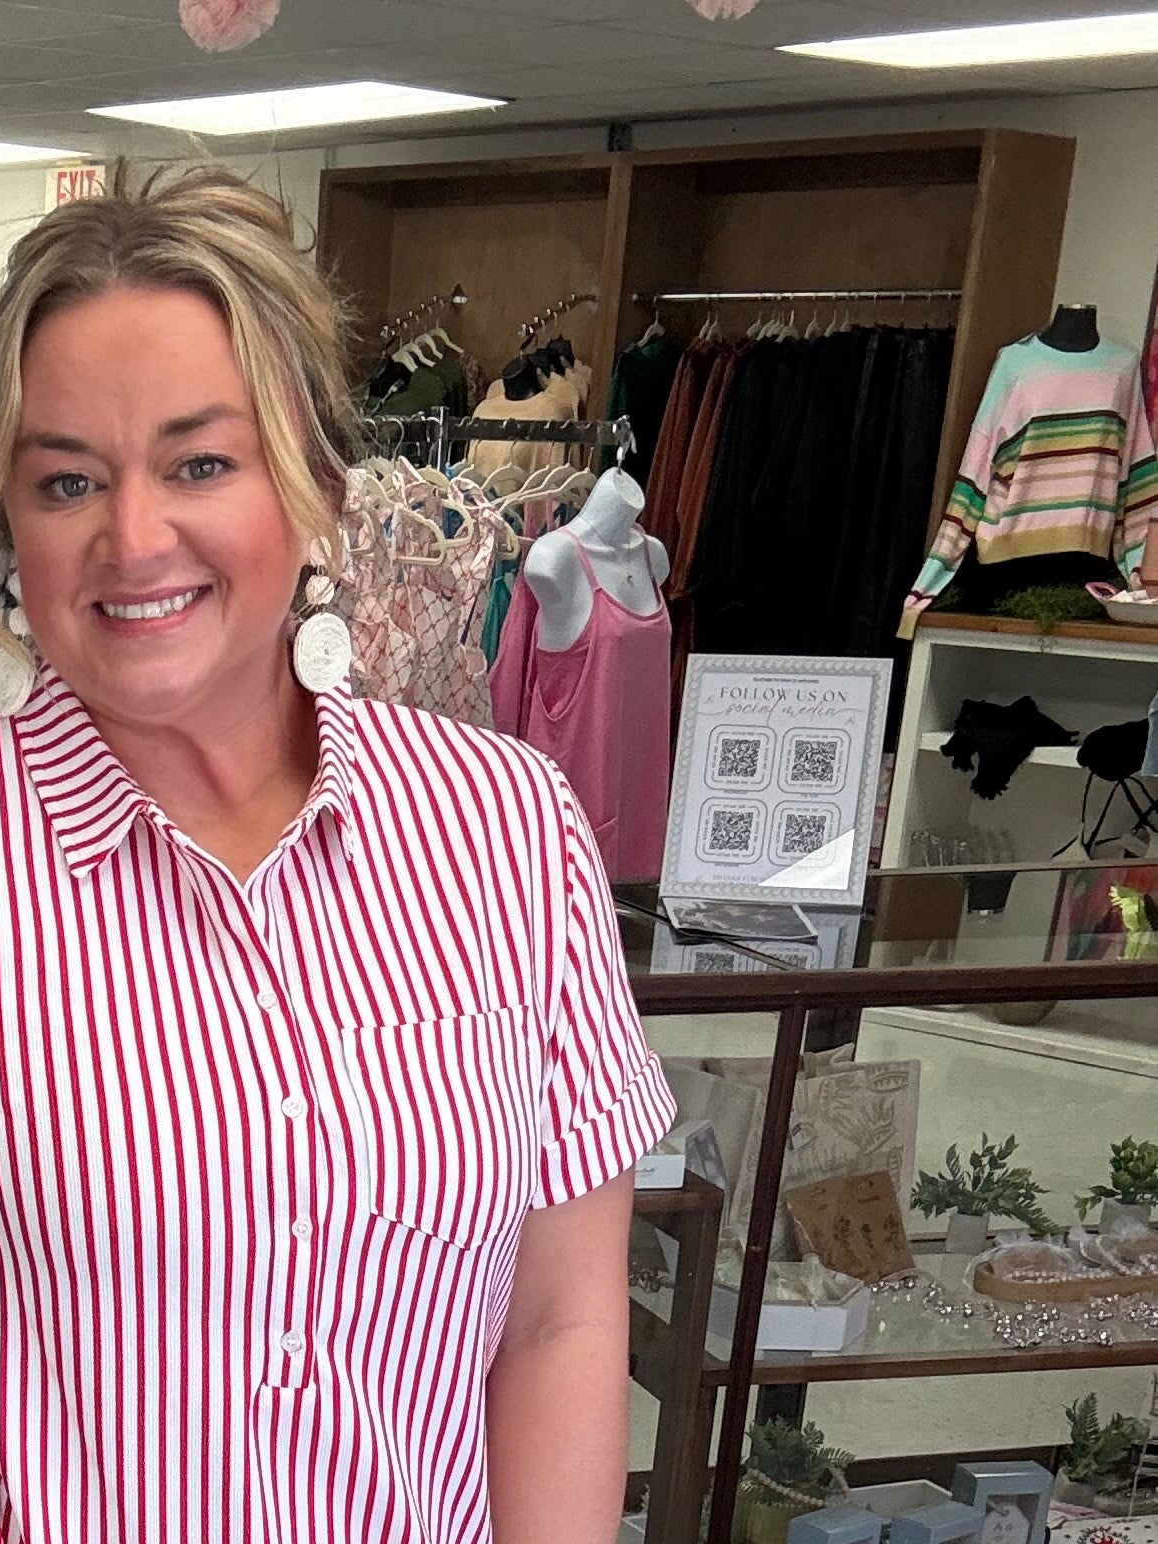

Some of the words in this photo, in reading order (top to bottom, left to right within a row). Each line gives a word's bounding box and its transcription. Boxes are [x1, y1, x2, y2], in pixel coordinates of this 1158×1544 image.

[57, 170, 96, 204] EXIT
[719, 686, 787, 701] FOLLOW
[796, 688, 817, 702] US
[822, 689, 848, 703] ON
